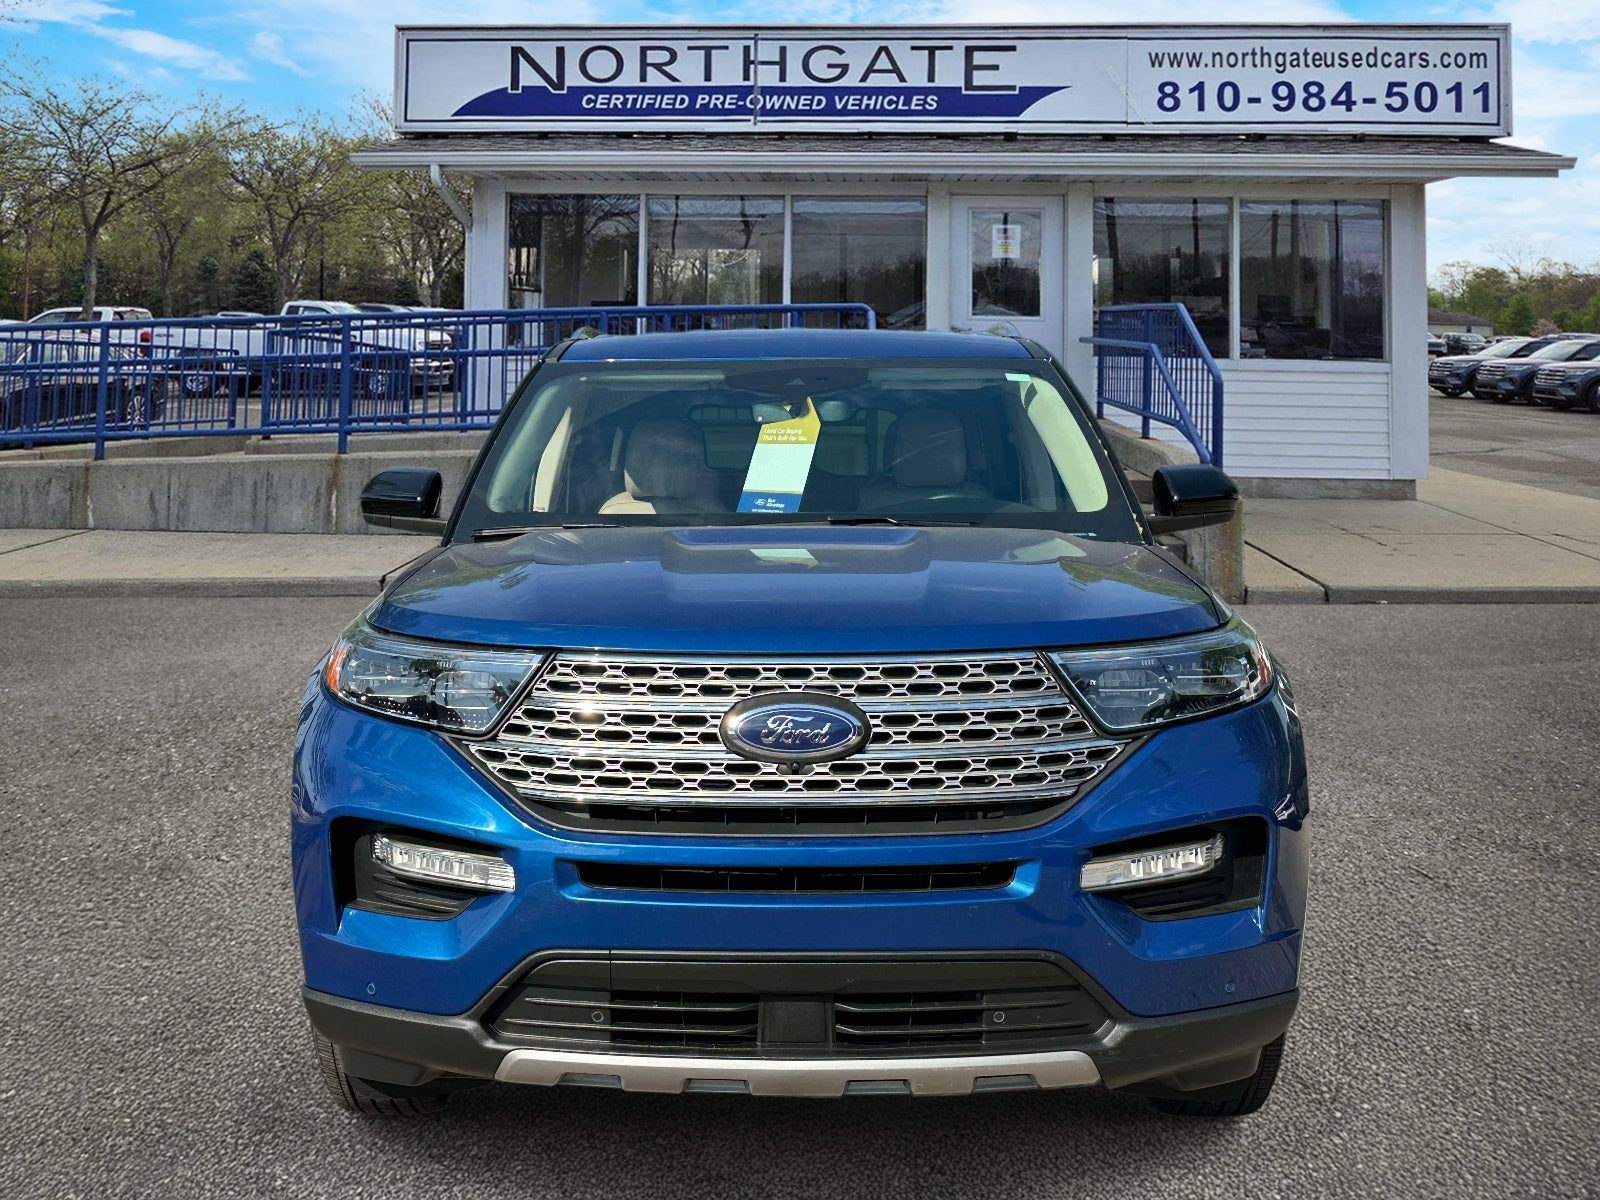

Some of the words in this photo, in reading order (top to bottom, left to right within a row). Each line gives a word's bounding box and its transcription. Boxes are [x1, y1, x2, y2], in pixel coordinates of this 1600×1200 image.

[508, 44, 1018, 93] NORTHGATE
[1148, 46, 1488, 73] www.northgateusedcars.com
[581, 94, 690, 110] CERTIFIED
[695, 94, 827, 110] PRE-OWNED
[834, 94, 939, 110] VEHICLES
[1156, 80, 1491, 113] 810-984-5011
[760, 714, 832, 744] Ford
